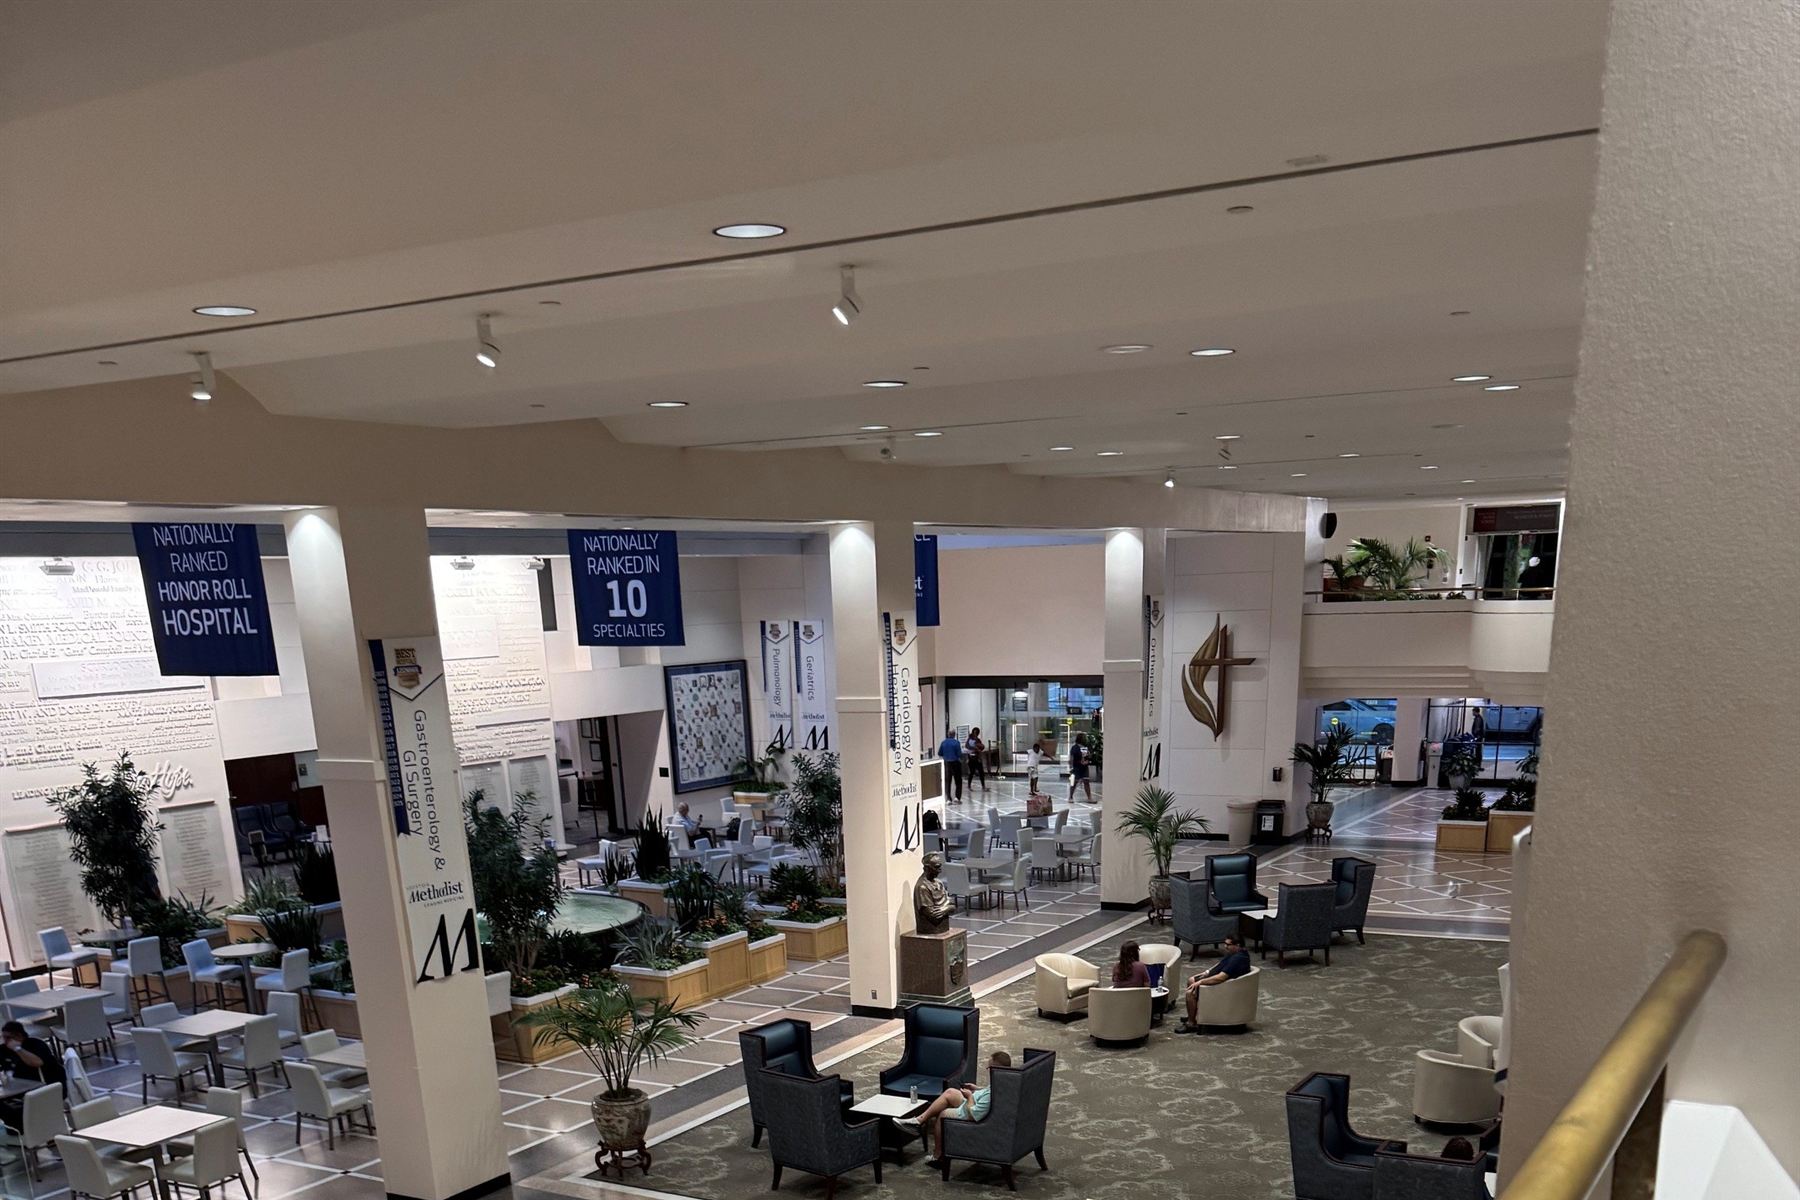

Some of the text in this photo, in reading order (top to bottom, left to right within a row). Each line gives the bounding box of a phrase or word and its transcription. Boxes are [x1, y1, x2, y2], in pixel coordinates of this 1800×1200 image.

[153, 523, 236, 547] NATIONALLY
[583, 533, 659, 553] NATIONALLY
[170, 550, 228, 574] RANKED
[587, 555, 660, 575] RANKED IN
[158, 578, 252, 602] HONOR ROLL
[606, 579, 648, 618] 10
[162, 607, 258, 636] HOSPITAL
[593, 623, 666, 638] SPECIALTIES
[394, 648, 416, 658] BEST
[806, 655, 815, 701] Geriatrics
[901, 667, 914, 769] Cardiology &
[801, 725, 829, 750] M
[403, 750, 423, 836] GI Surgery
[414, 709, 446, 871] Gastroenterology &
[890, 802, 920, 855] M
[408, 881, 464, 904] Methodist
[416, 907, 480, 984] M
